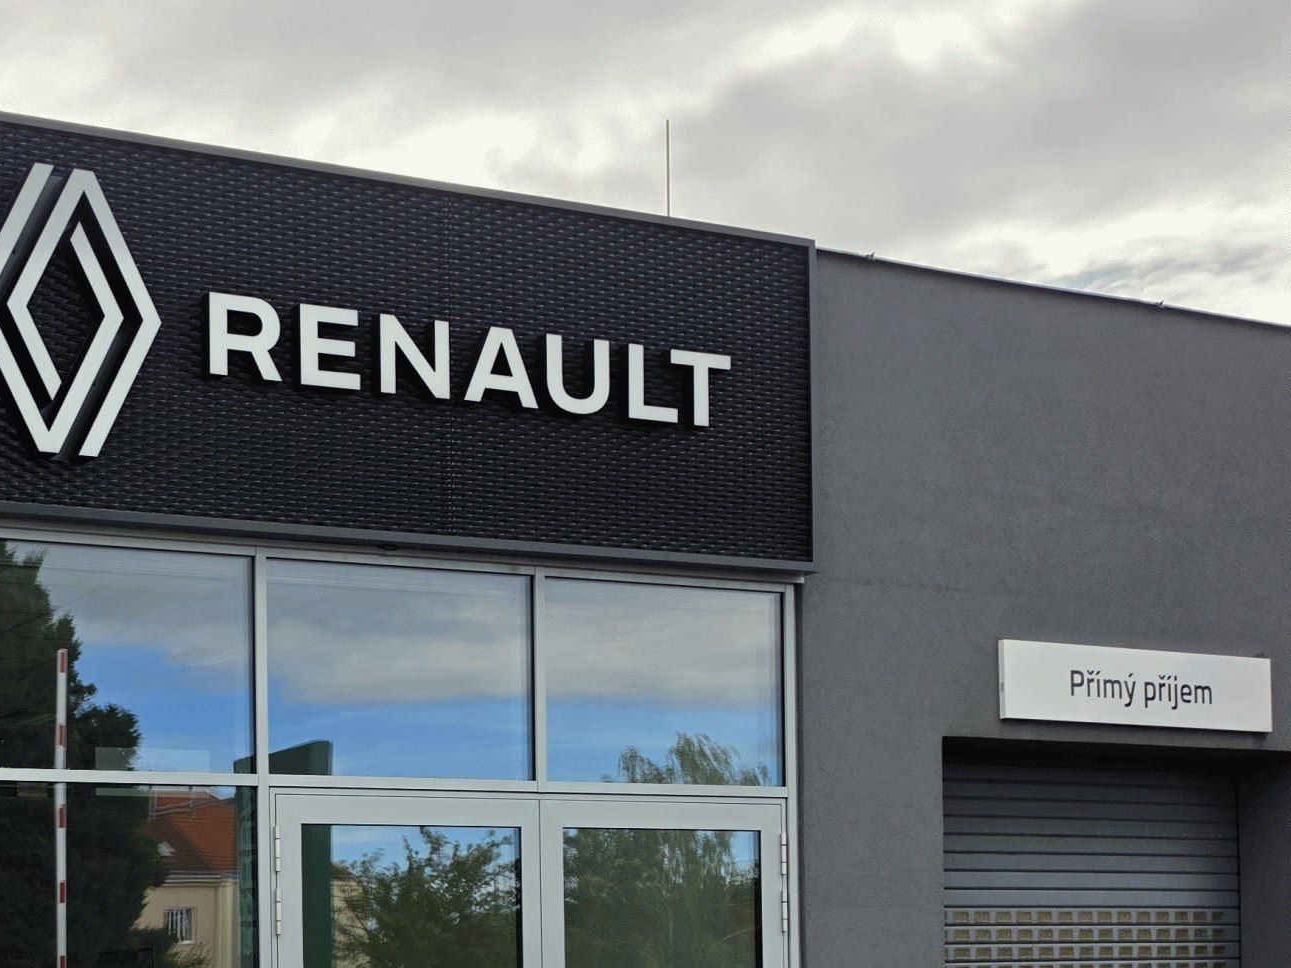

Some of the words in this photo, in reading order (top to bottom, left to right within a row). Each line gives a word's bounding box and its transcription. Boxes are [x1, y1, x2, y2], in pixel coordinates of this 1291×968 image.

[209, 291, 732, 428] RENAULT
[1070, 669, 1136, 708] Přímý
[1144, 674, 1213, 711] příjem
